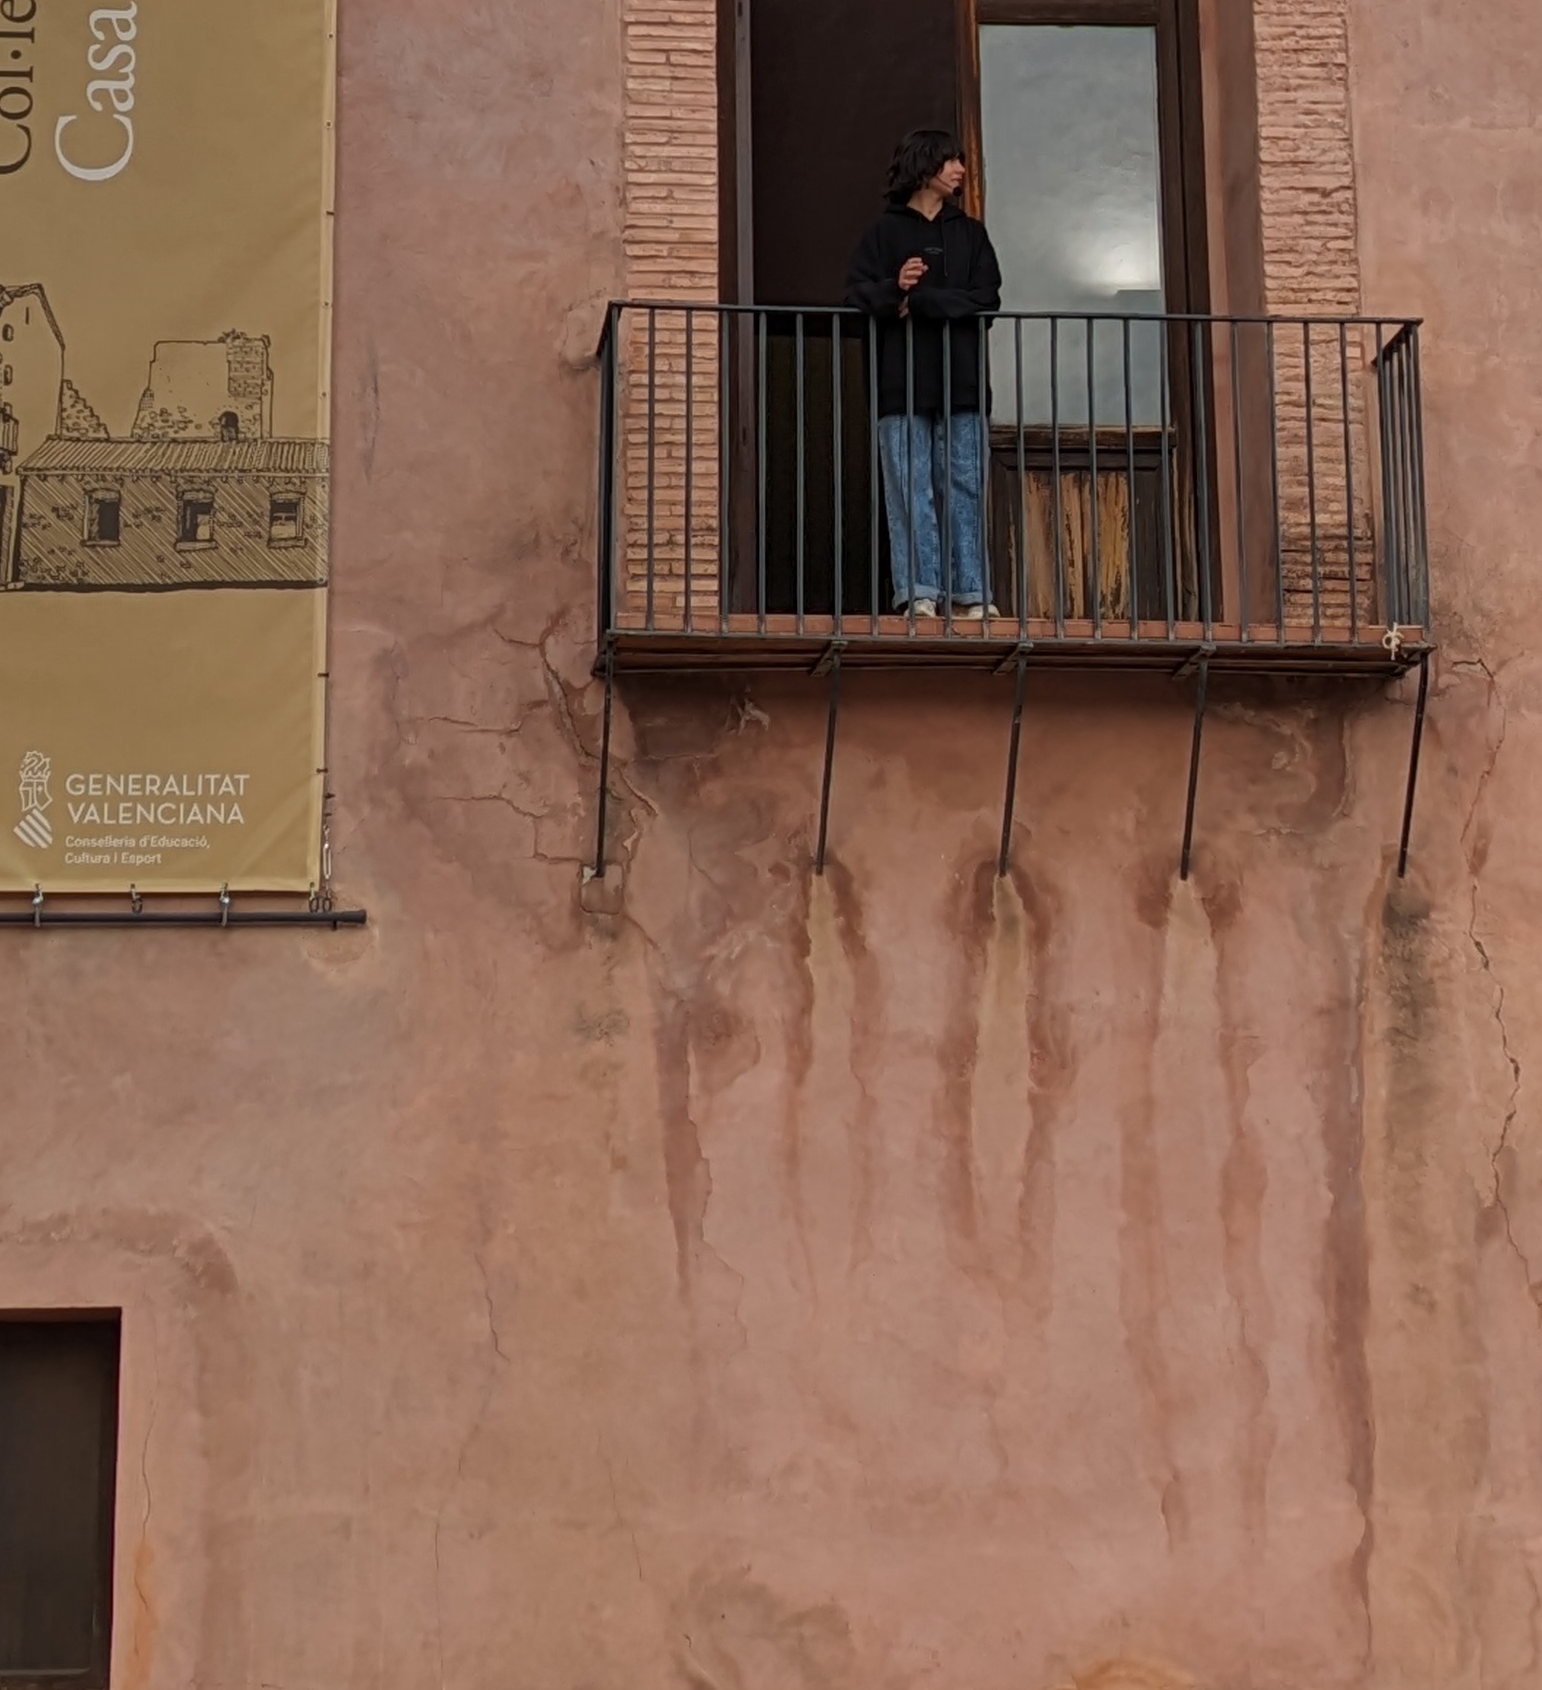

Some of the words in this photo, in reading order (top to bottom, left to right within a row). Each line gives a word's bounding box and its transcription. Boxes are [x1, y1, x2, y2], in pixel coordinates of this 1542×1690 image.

[54, 0, 138, 182] Casa
[65, 773, 250, 796] GENERALITAT
[67, 802, 245, 825] VALENCIANA
